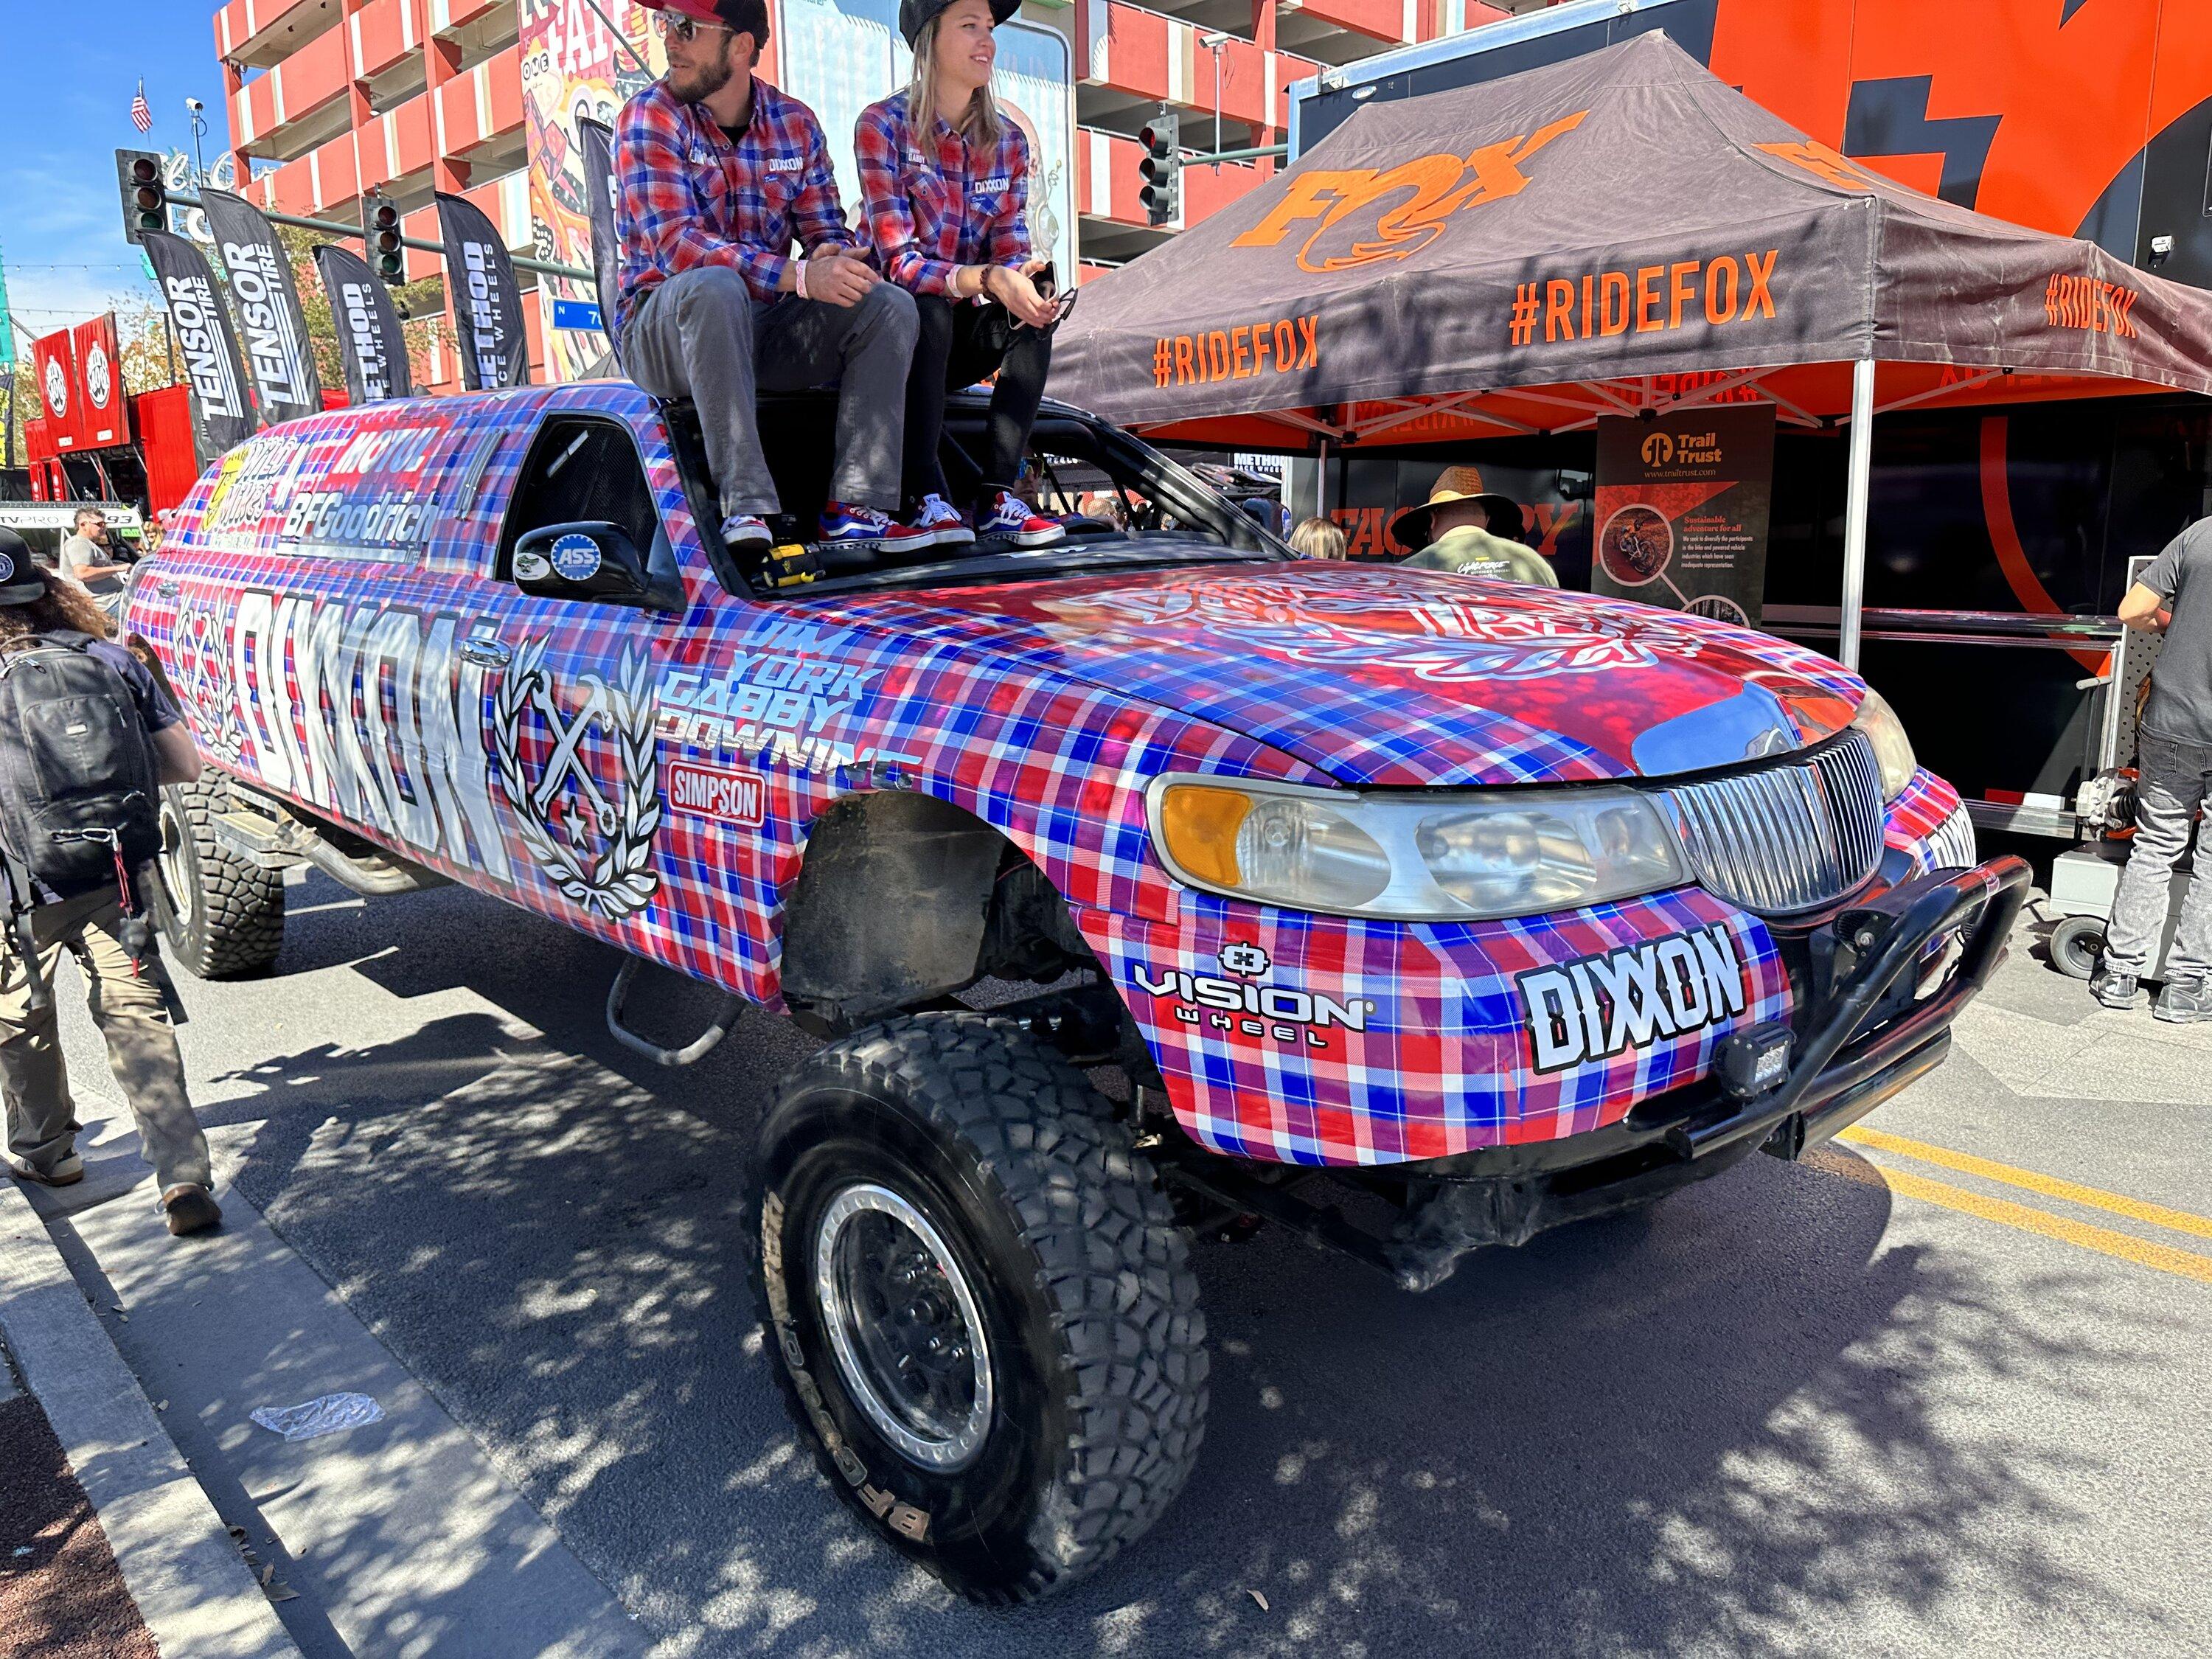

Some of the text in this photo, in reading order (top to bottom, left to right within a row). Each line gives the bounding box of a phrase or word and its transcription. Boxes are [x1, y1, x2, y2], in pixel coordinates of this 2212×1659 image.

[769, 156, 803, 171] DIXXON
[975, 178, 1009, 193] DIXXON
[1229, 111, 1590, 273] FOX
[254, 241, 283, 293] TIRE
[484, 243, 504, 341] WHEELS
[192, 275, 218, 321] TIRE
[558, 306, 565, 315] N
[1509, 250, 1778, 346] #RIDEFOX
[2045, 274, 2138, 339] #RIDEFOX
[166, 276, 229, 420] TENSOR
[223, 242, 294, 408] TENSOR
[362, 283, 387, 368] WHEELS
[1152, 315, 1318, 389] #RIDEFOX
[332, 426, 441, 474] MOTUL
[1677, 433, 1716, 448] Trail
[1677, 448, 1722, 464] Trust
[1644, 468, 1716, 479] www.trailtrust.com
[281, 491, 439, 542] BFGoodrich
[1330, 504, 1579, 556] FACY
[1683, 524, 1742, 532] adventure for all
[1684, 516, 1726, 524] Sustainable
[558, 548, 596, 565] ASS
[737, 621, 855, 655] JIM
[730, 649, 885, 700] YORK
[658, 671, 854, 733] GABBY
[233, 590, 513, 885] DIXXON
[655, 706, 924, 790] DOWNING
[673, 769, 758, 818] SIMPSON
[1133, 964, 1365, 1031] VISION
[1520, 925, 1745, 1070] DIXXON
[1175, 1006, 1326, 1046] WHEEL
